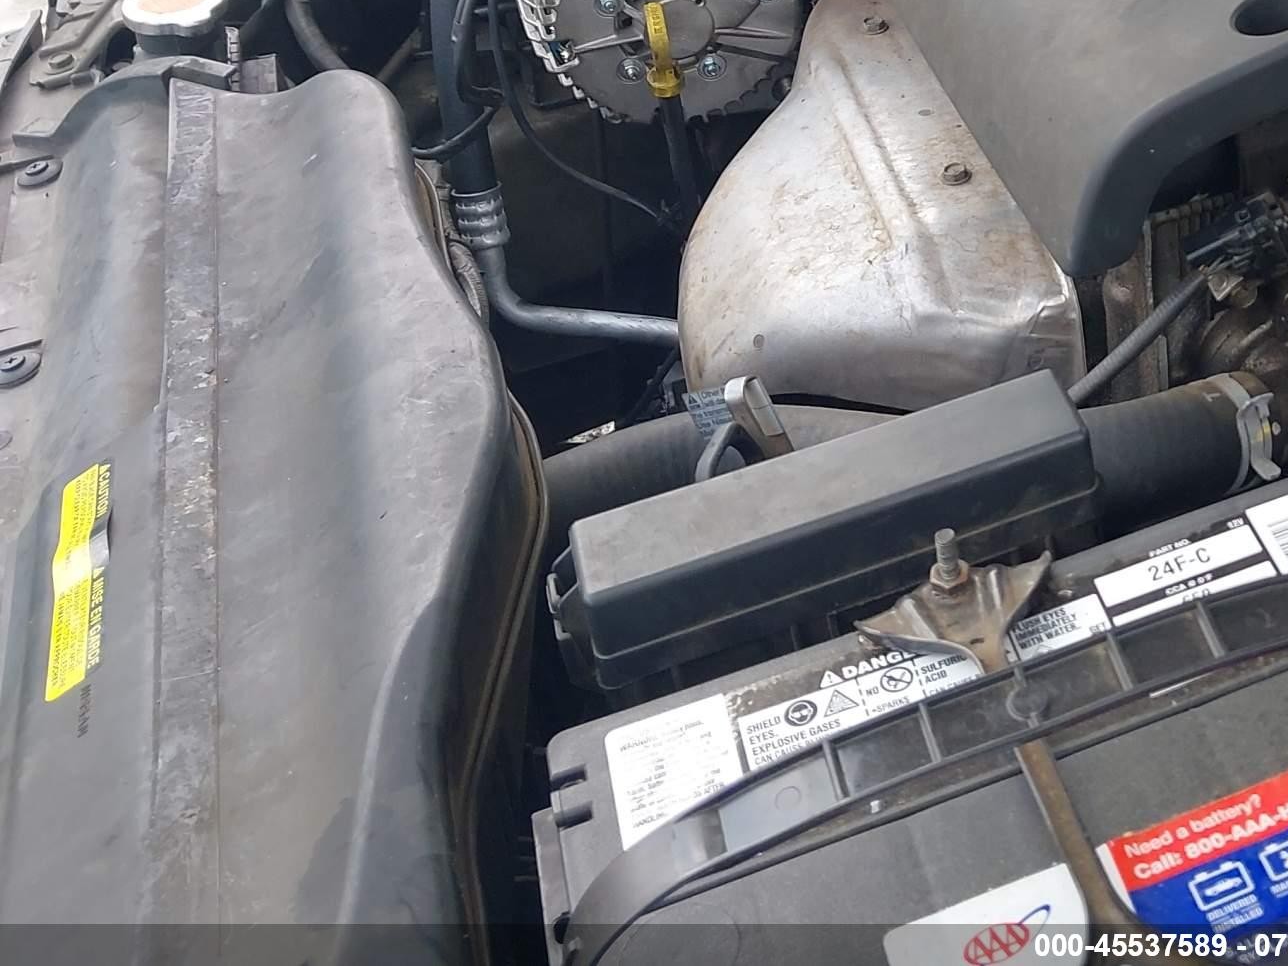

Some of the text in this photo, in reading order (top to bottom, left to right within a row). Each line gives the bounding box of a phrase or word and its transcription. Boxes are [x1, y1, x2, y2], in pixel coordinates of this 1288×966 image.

[96, 471, 110, 518] CAUTION
[1149, 544, 1173, 558] PART
[1149, 547, 1211, 581] 24F-C
[92, 577, 105, 608] MISE
[1165, 583, 1187, 596] CCA
[90, 606, 102, 627] EN
[1042, 608, 1067, 622] EYES
[1014, 613, 1077, 641] IMMEDIATELY
[1018, 636, 1044, 650] WITH
[921, 654, 968, 675] SULFURIC
[925, 670, 948, 685] ACID
[865, 685, 881, 697] NO
[747, 715, 782, 734] SHIELD
[751, 730, 807, 756] EXPLOSIVE
[809, 718, 842, 737] GASES
[1124, 793, 1263, 858] Need a battery?
[1133, 853, 1183, 880] Call:
[1206, 893, 1259, 921] DELIVERED
